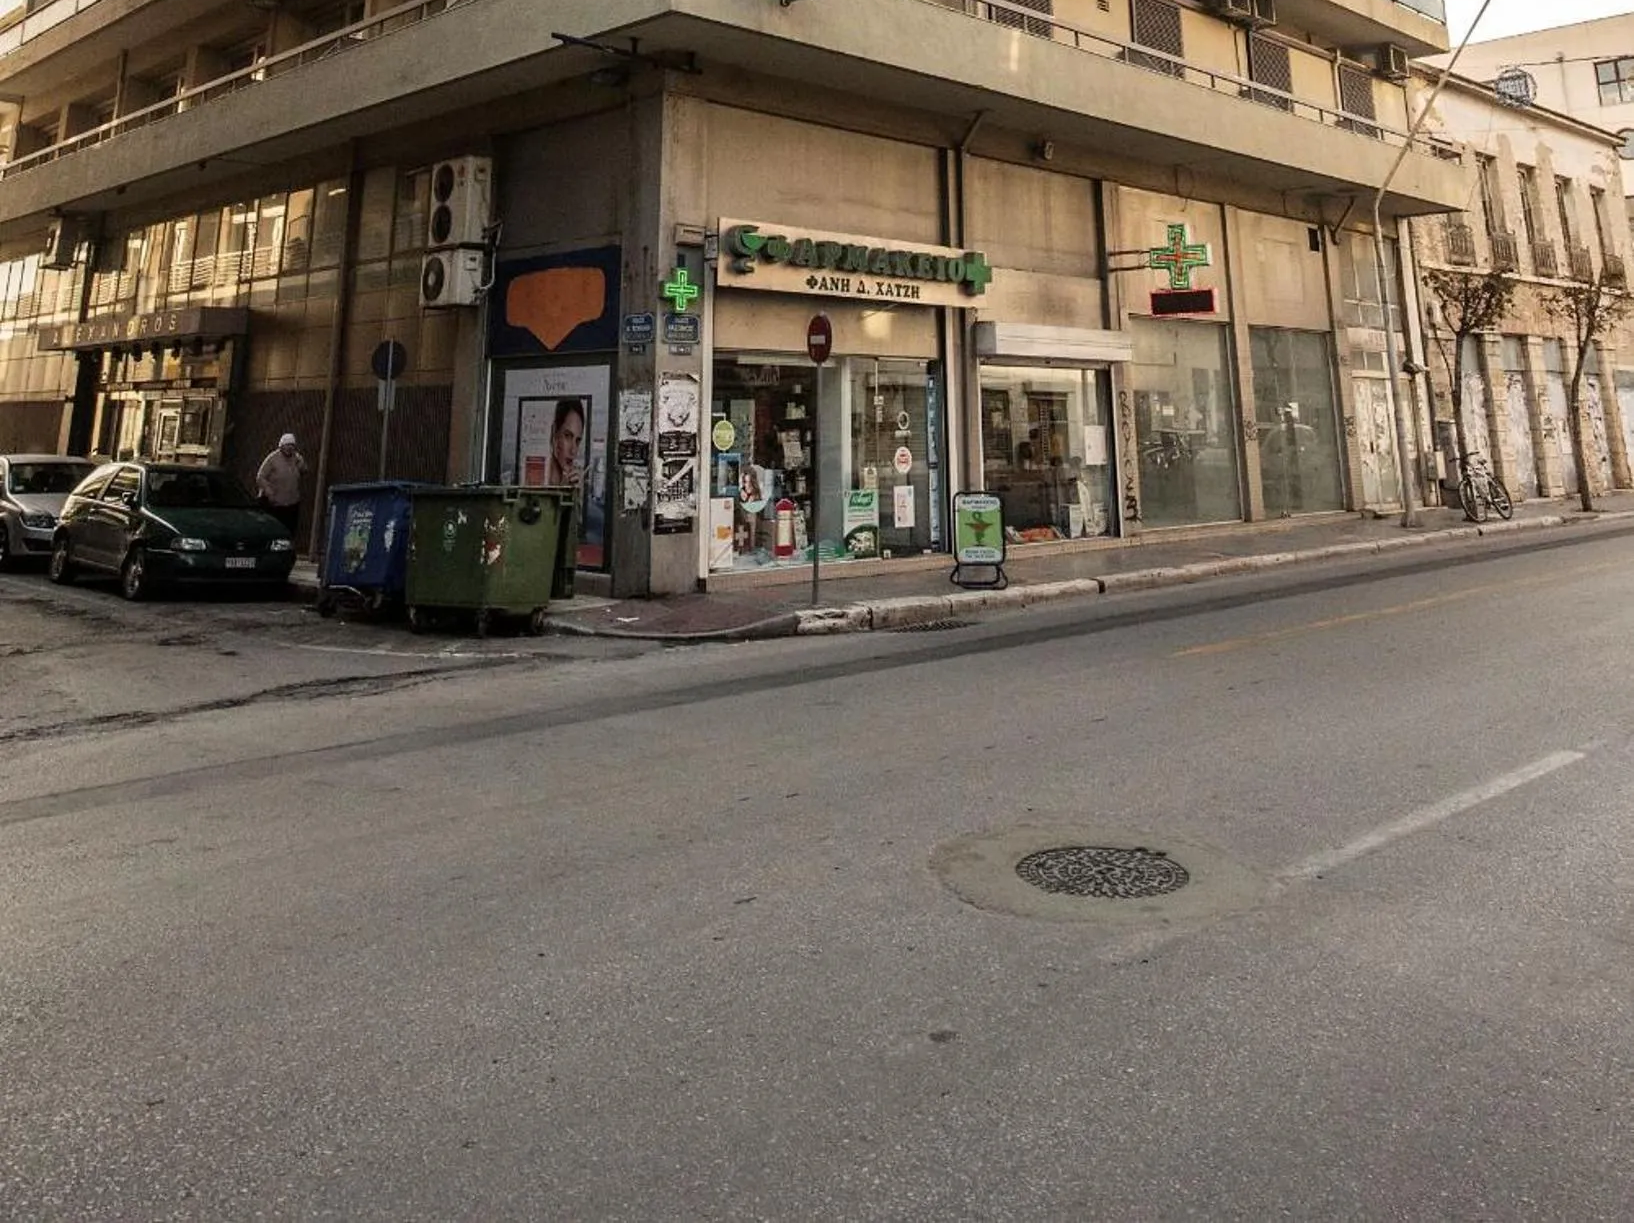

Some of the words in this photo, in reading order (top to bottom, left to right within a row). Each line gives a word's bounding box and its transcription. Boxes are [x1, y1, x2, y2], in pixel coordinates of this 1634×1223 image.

[763, 235, 966, 282] ΦΑΡΜΑΚΕΙΟ
[805, 275, 851, 294] ΦΑΝΗ
[856, 279, 870, 295] Δ.
[875, 282, 921, 299] ΧΑΤΖΗ
